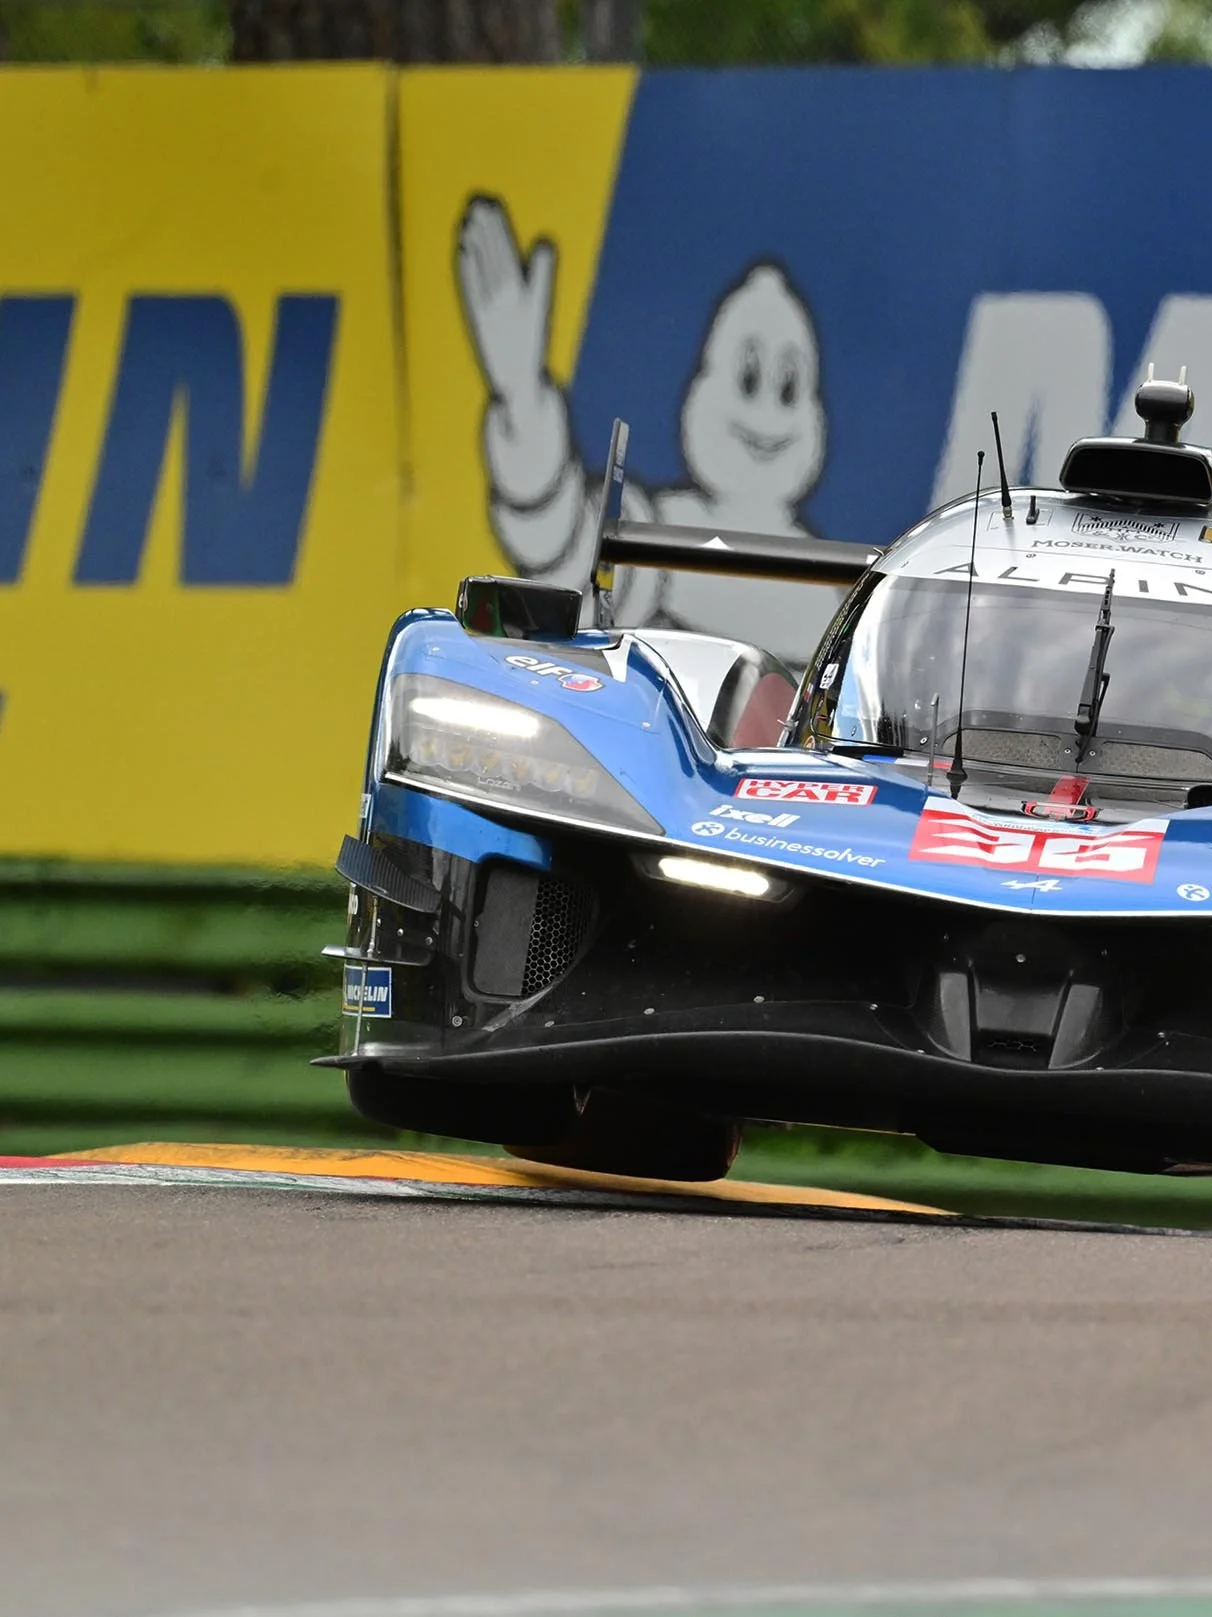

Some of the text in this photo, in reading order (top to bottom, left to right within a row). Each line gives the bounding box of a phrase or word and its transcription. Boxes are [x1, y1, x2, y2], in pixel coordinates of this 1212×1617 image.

[745, 786, 862, 804] CAR
[749, 780, 865, 793] HYPER
[709, 804, 801, 828] ixell
[724, 827, 886, 869] businessolver
[918, 819, 1156, 873] 36
